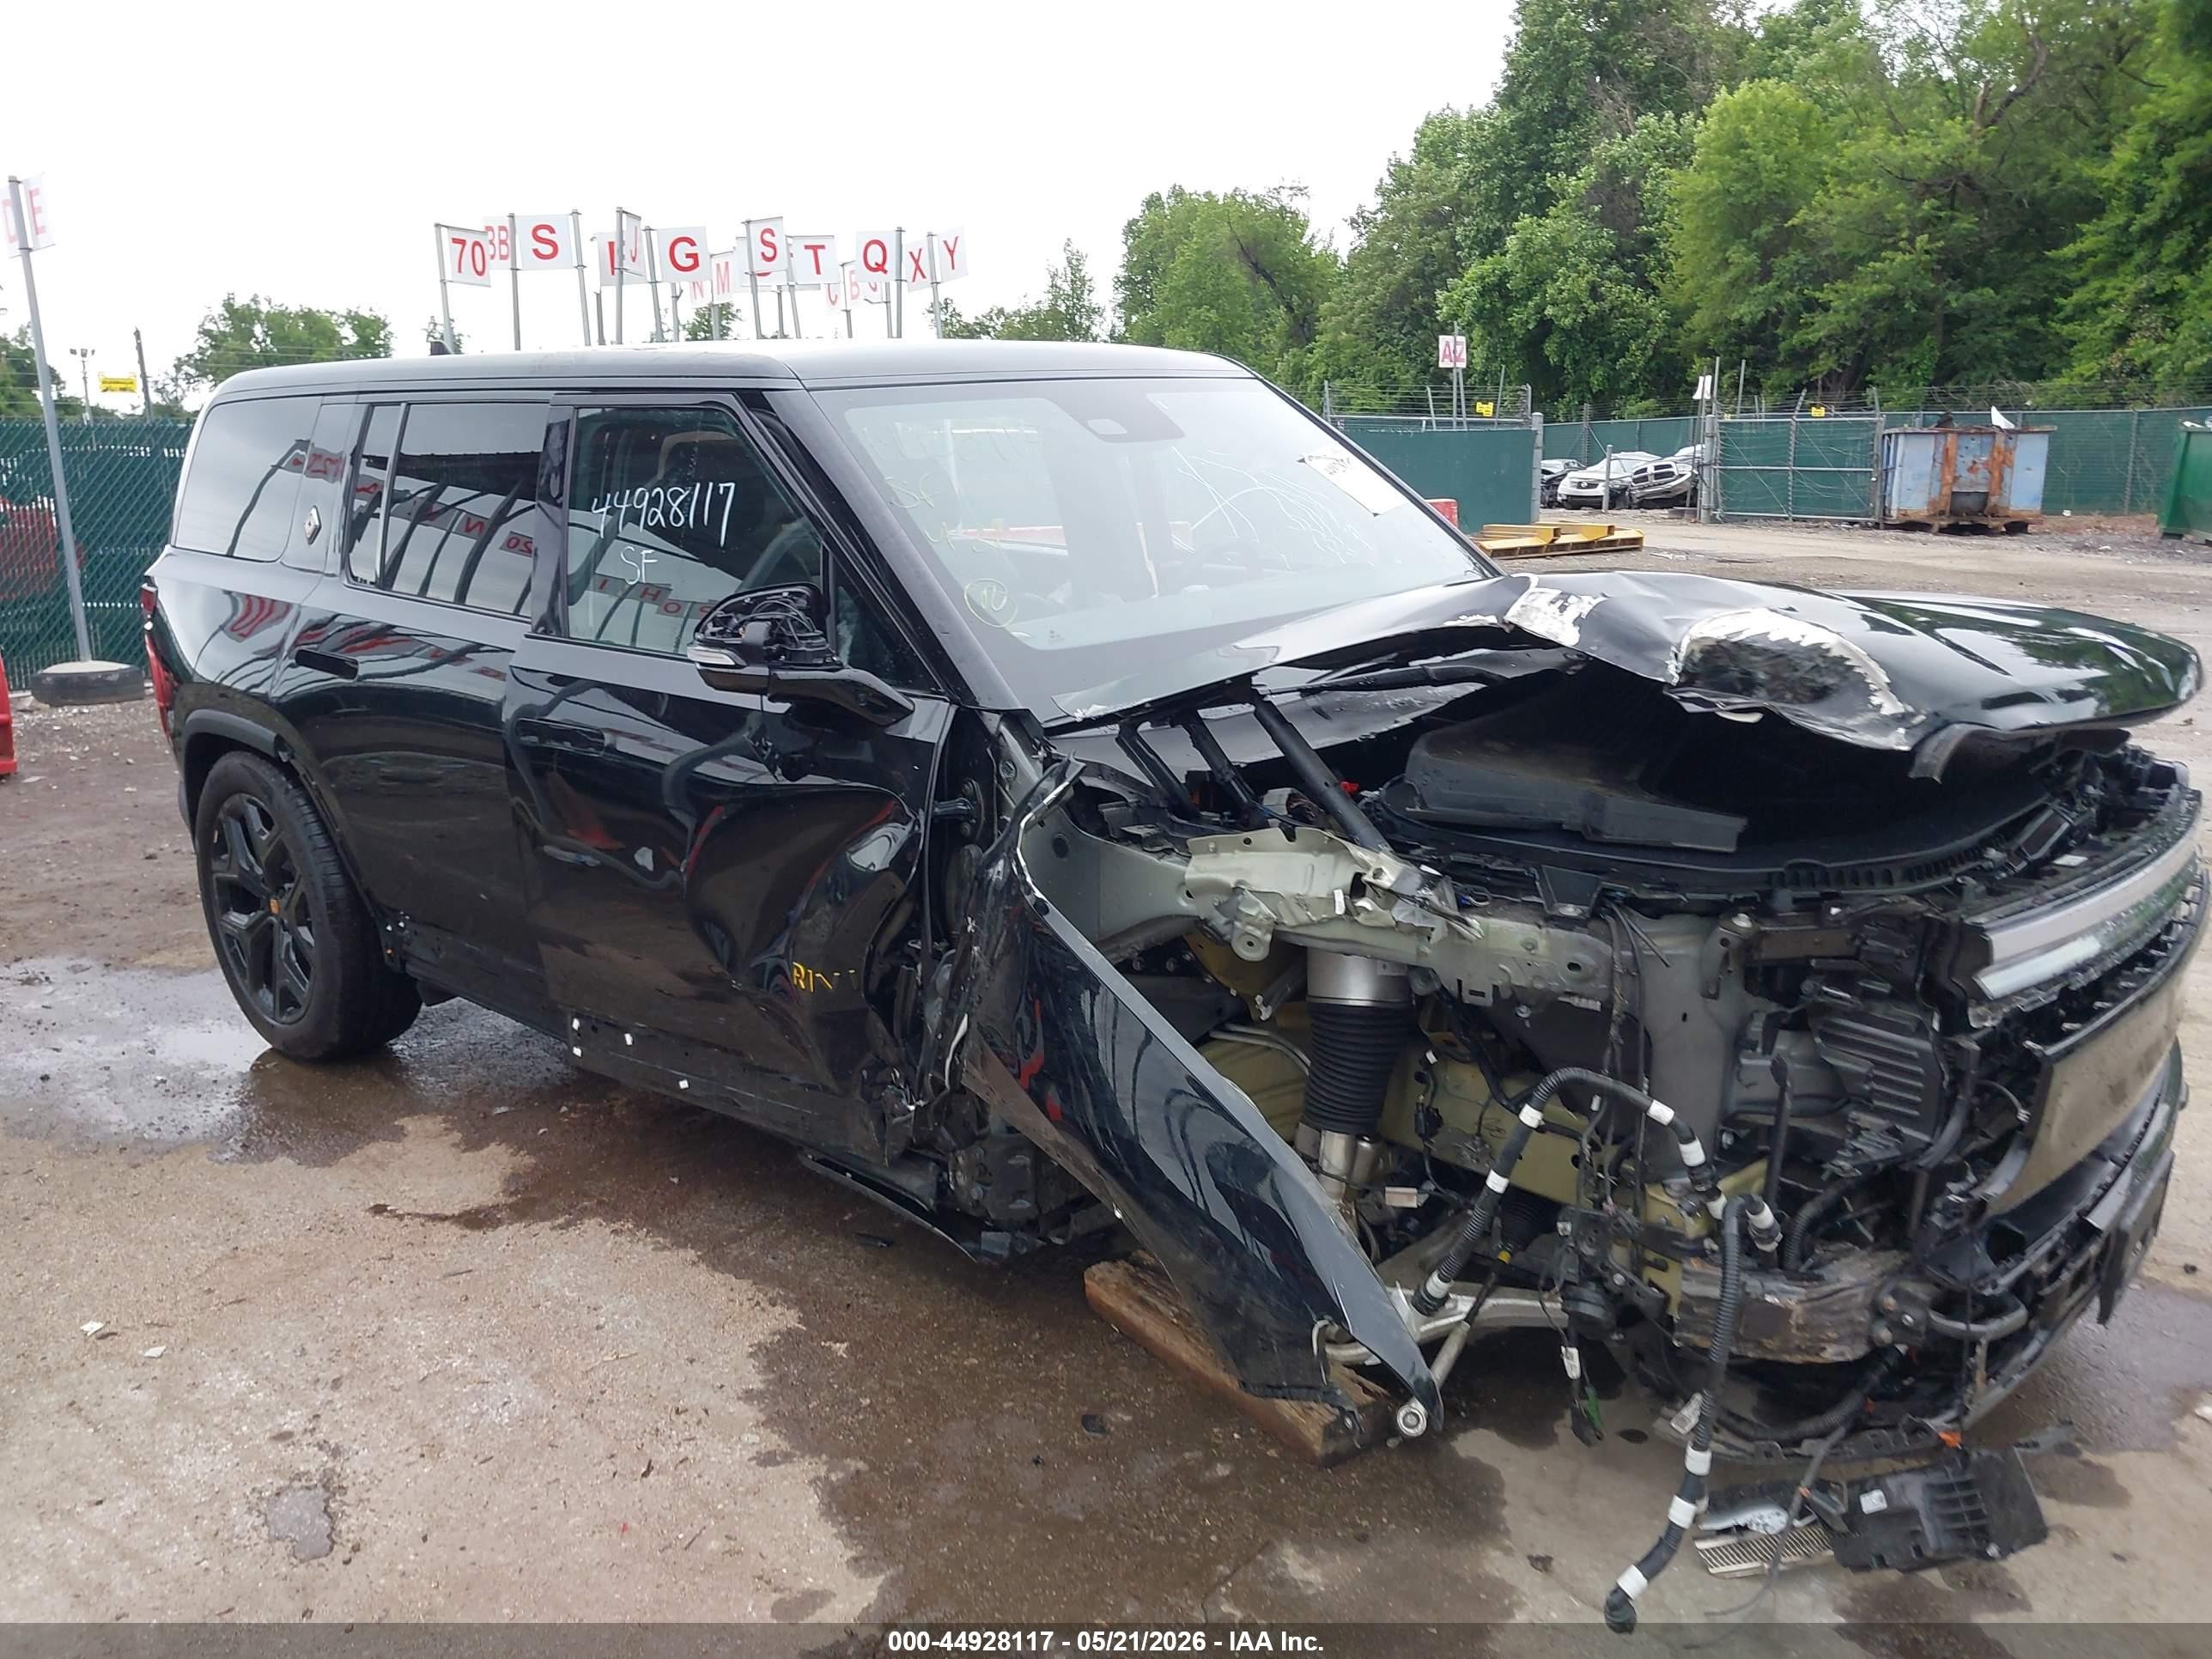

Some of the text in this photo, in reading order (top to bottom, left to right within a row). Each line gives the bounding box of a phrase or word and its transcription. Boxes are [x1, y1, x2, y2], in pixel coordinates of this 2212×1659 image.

[29, 188, 46, 234] E
[452, 238, 487, 276] 70
[531, 224, 559, 260] S
[669, 236, 700, 272] G
[760, 228, 777, 263] S
[804, 245, 826, 275] T
[863, 239, 888, 275] Q
[943, 236, 958, 270] Y
[716, 261, 730, 296] M
[908, 248, 927, 283] X
[592, 482, 735, 547] 44928117
[621, 546, 658, 585] SF
